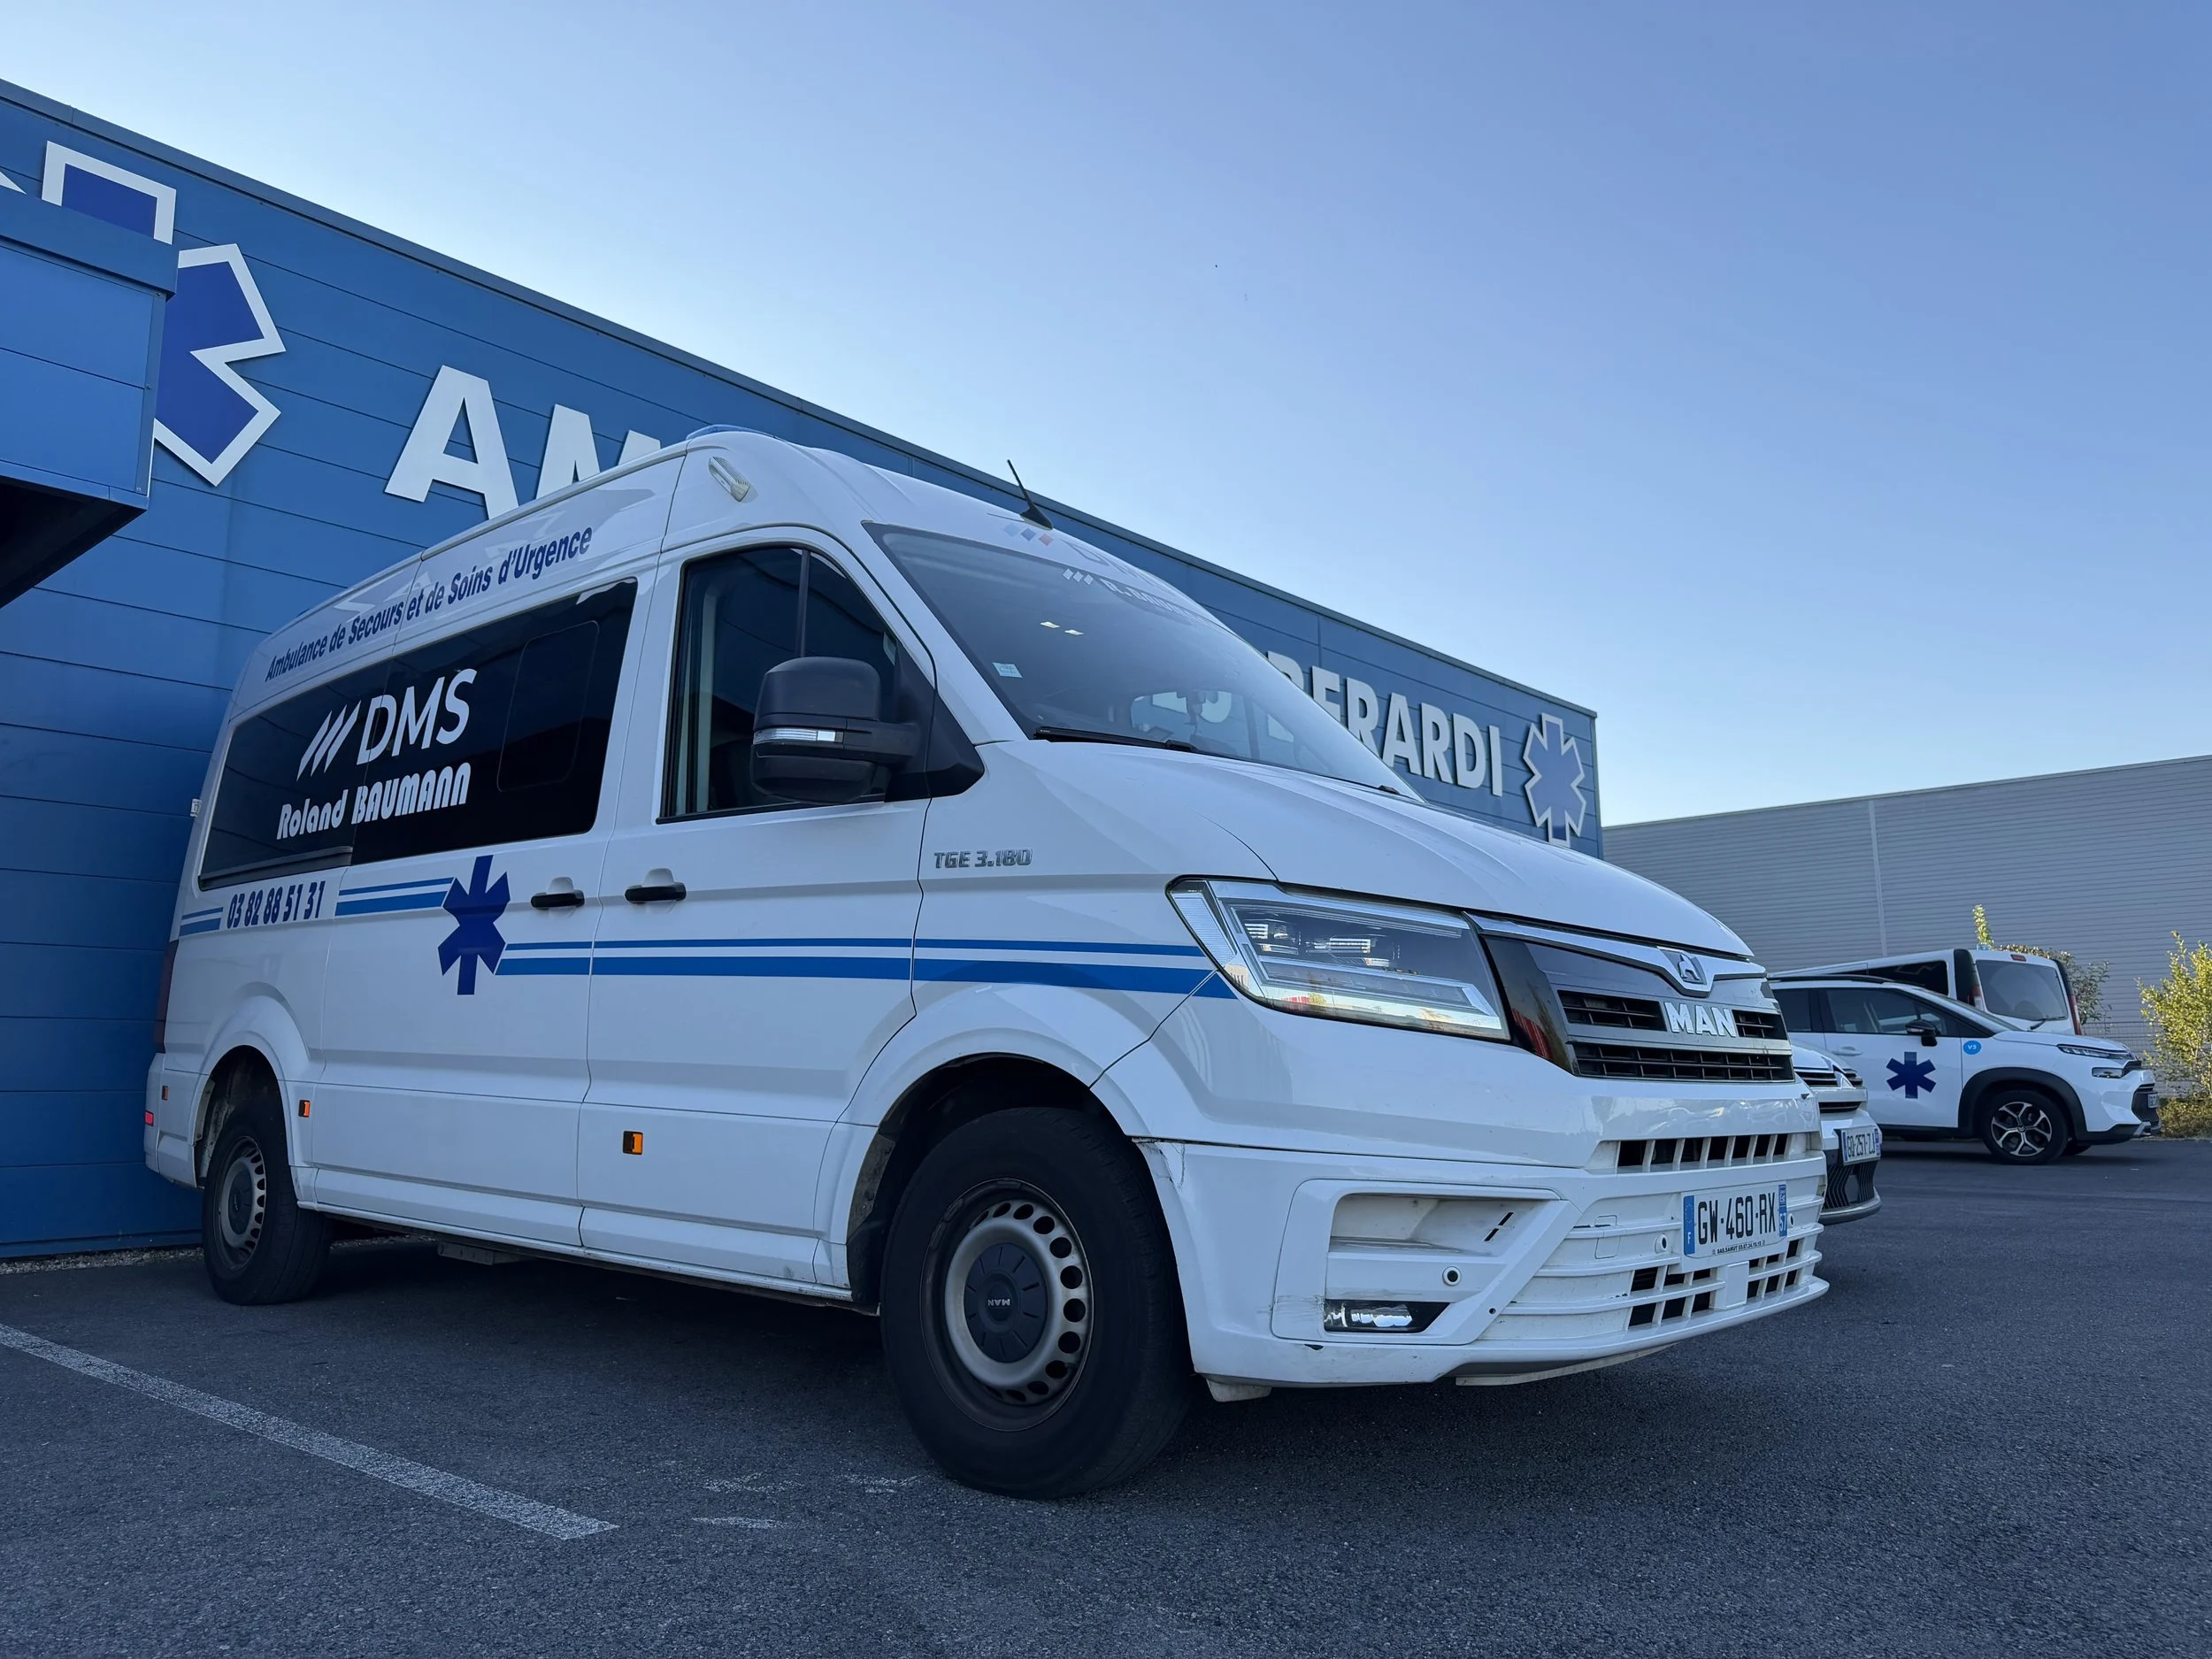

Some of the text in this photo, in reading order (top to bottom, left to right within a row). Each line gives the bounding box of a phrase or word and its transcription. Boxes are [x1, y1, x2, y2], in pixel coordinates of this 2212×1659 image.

[265, 526, 593, 682] Ambulance de Secours et de Soins d'Urgence
[356, 668, 478, 765] DMS
[276, 762, 472, 841] Roland BAUMANN
[933, 849, 1033, 869] TGE 3.180
[227, 880, 326, 929] 03 82 88 51 31
[1664, 1002, 1737, 1038] MAN
[1698, 1192, 1776, 1245] GW-460-RX
[1779, 1211, 1787, 1232] 57
[987, 1298, 1010, 1307] MAN
